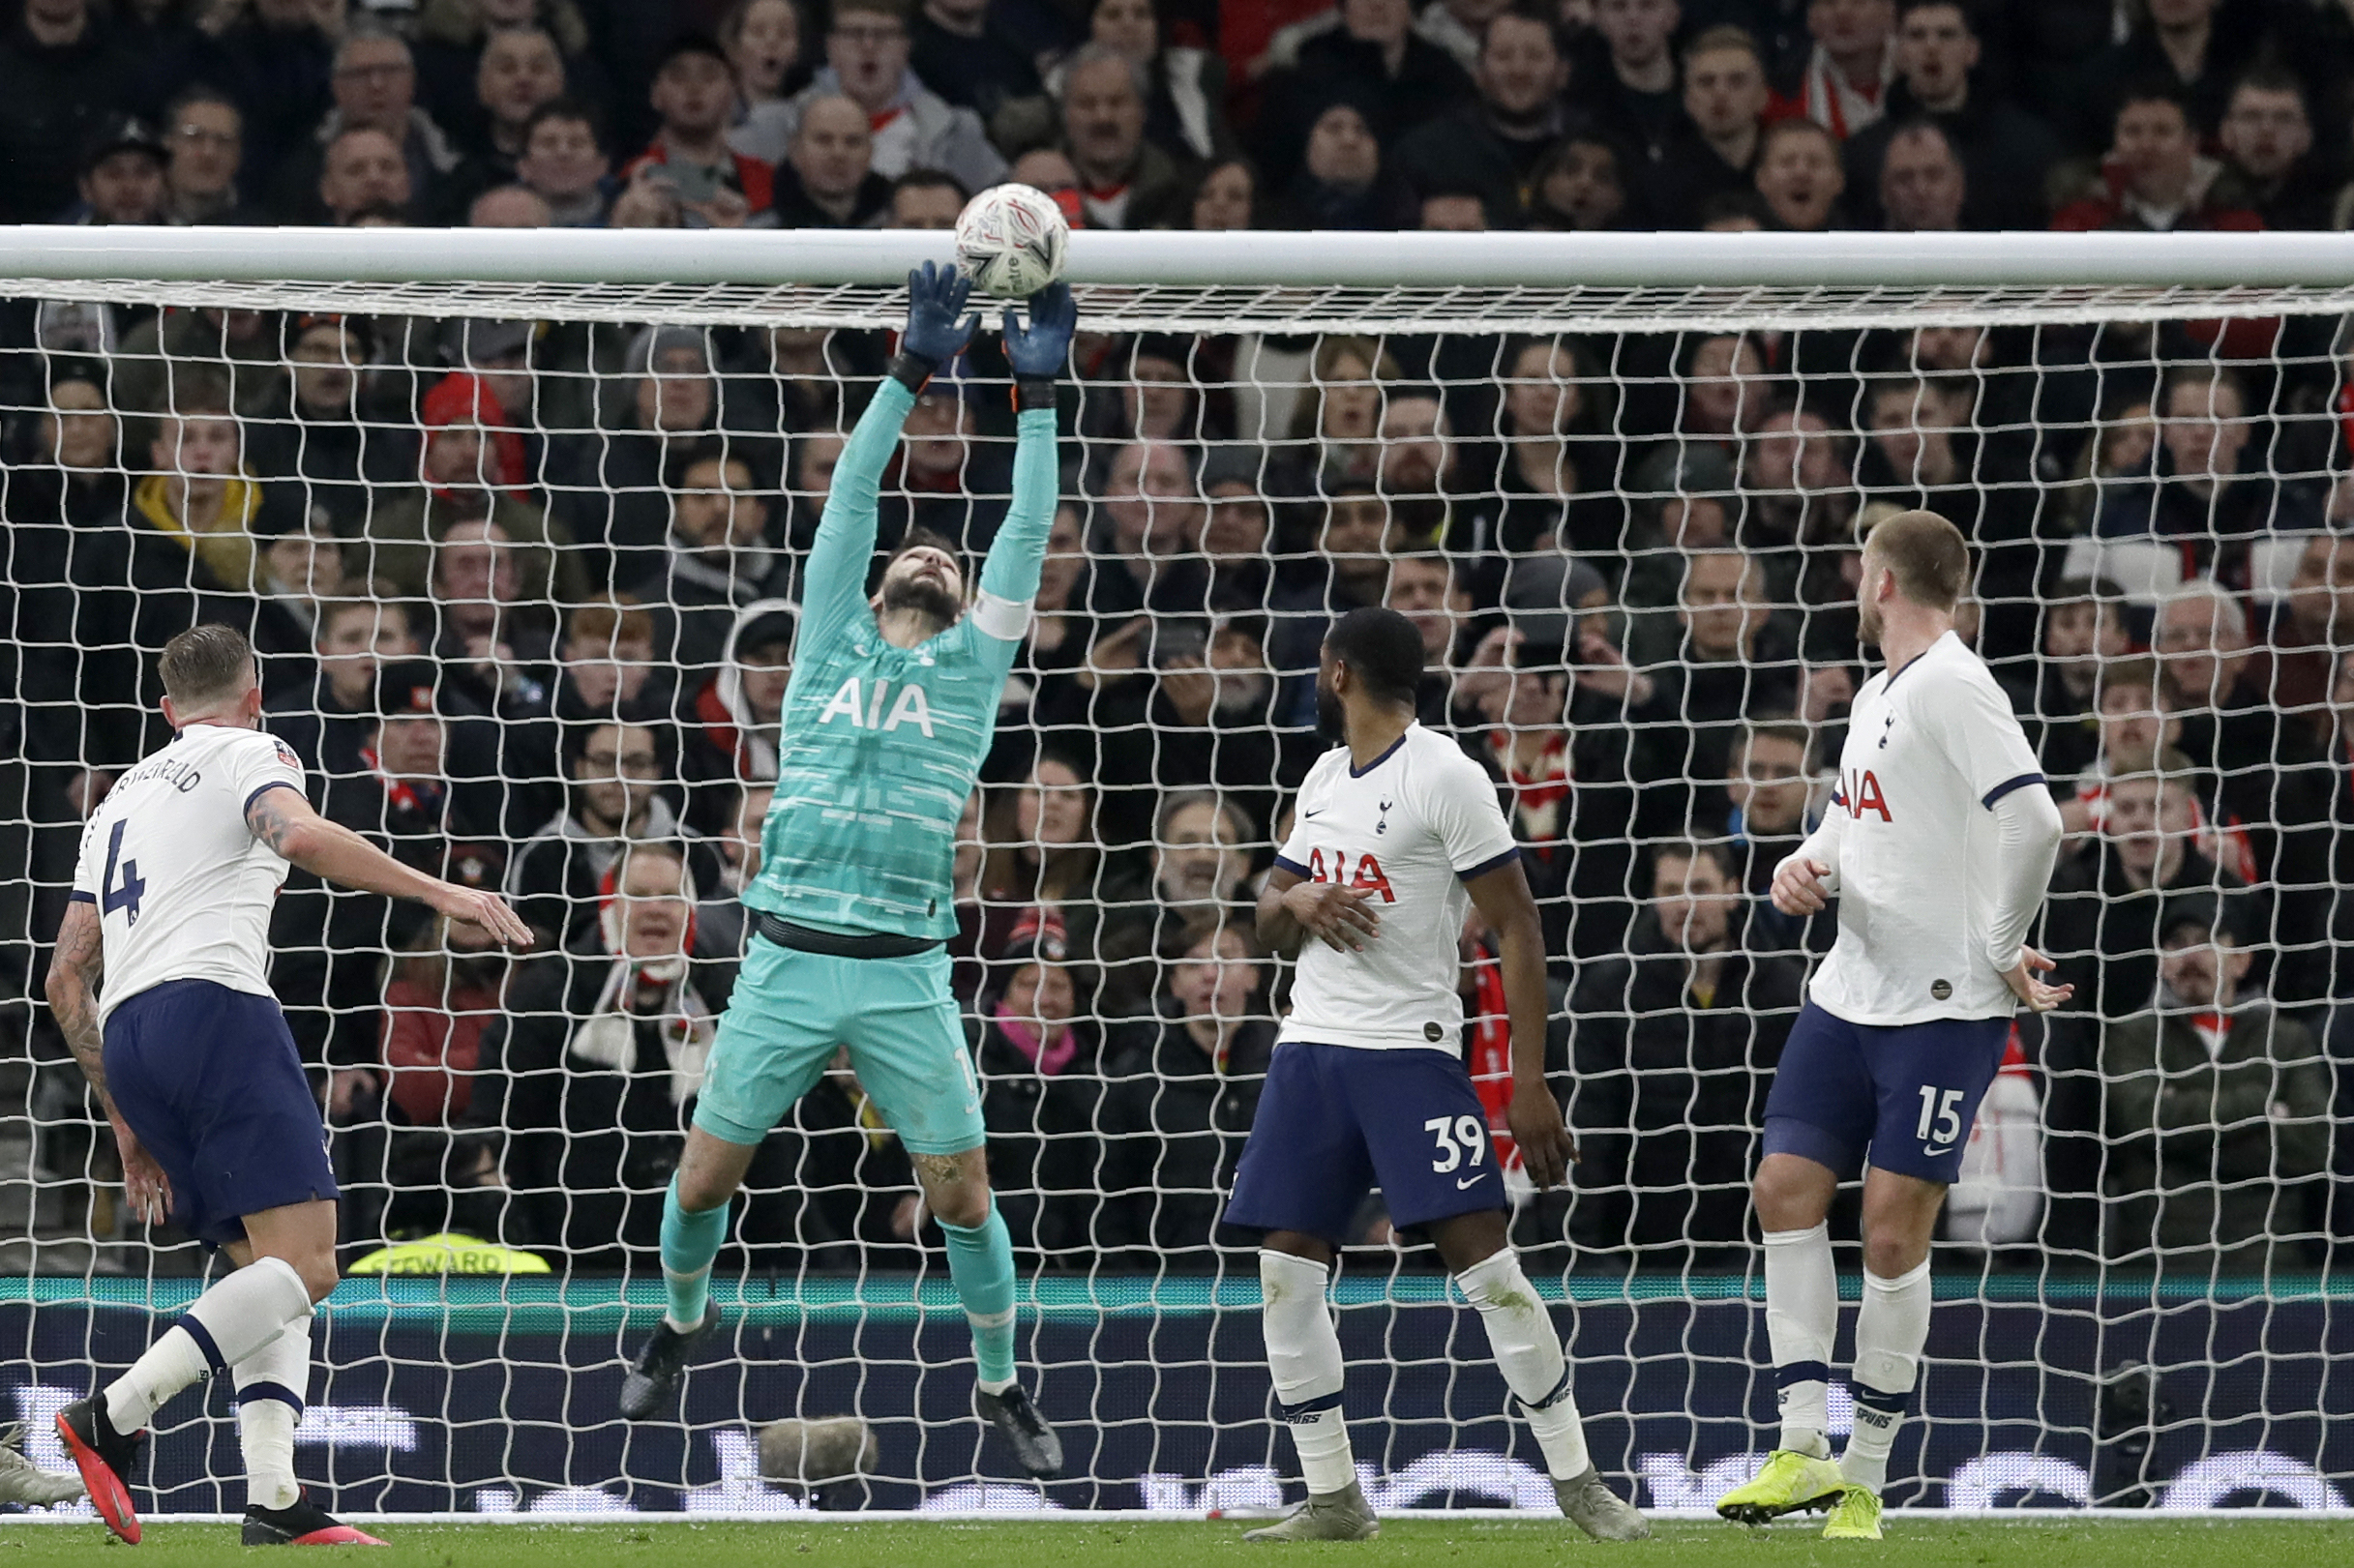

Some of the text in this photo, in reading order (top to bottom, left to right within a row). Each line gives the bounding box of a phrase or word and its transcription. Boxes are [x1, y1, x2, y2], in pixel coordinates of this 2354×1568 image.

[819, 677, 935, 738] AIA
[103, 818, 145, 928] 4
[1310, 847, 1396, 903] AIA
[954, 1048, 975, 1096] 1
[1917, 1084, 1964, 1144] 15
[1424, 1115, 1485, 1173] 39
[1285, 1413, 1323, 1425] PURS
[1857, 1407, 1892, 1429] SPURS
